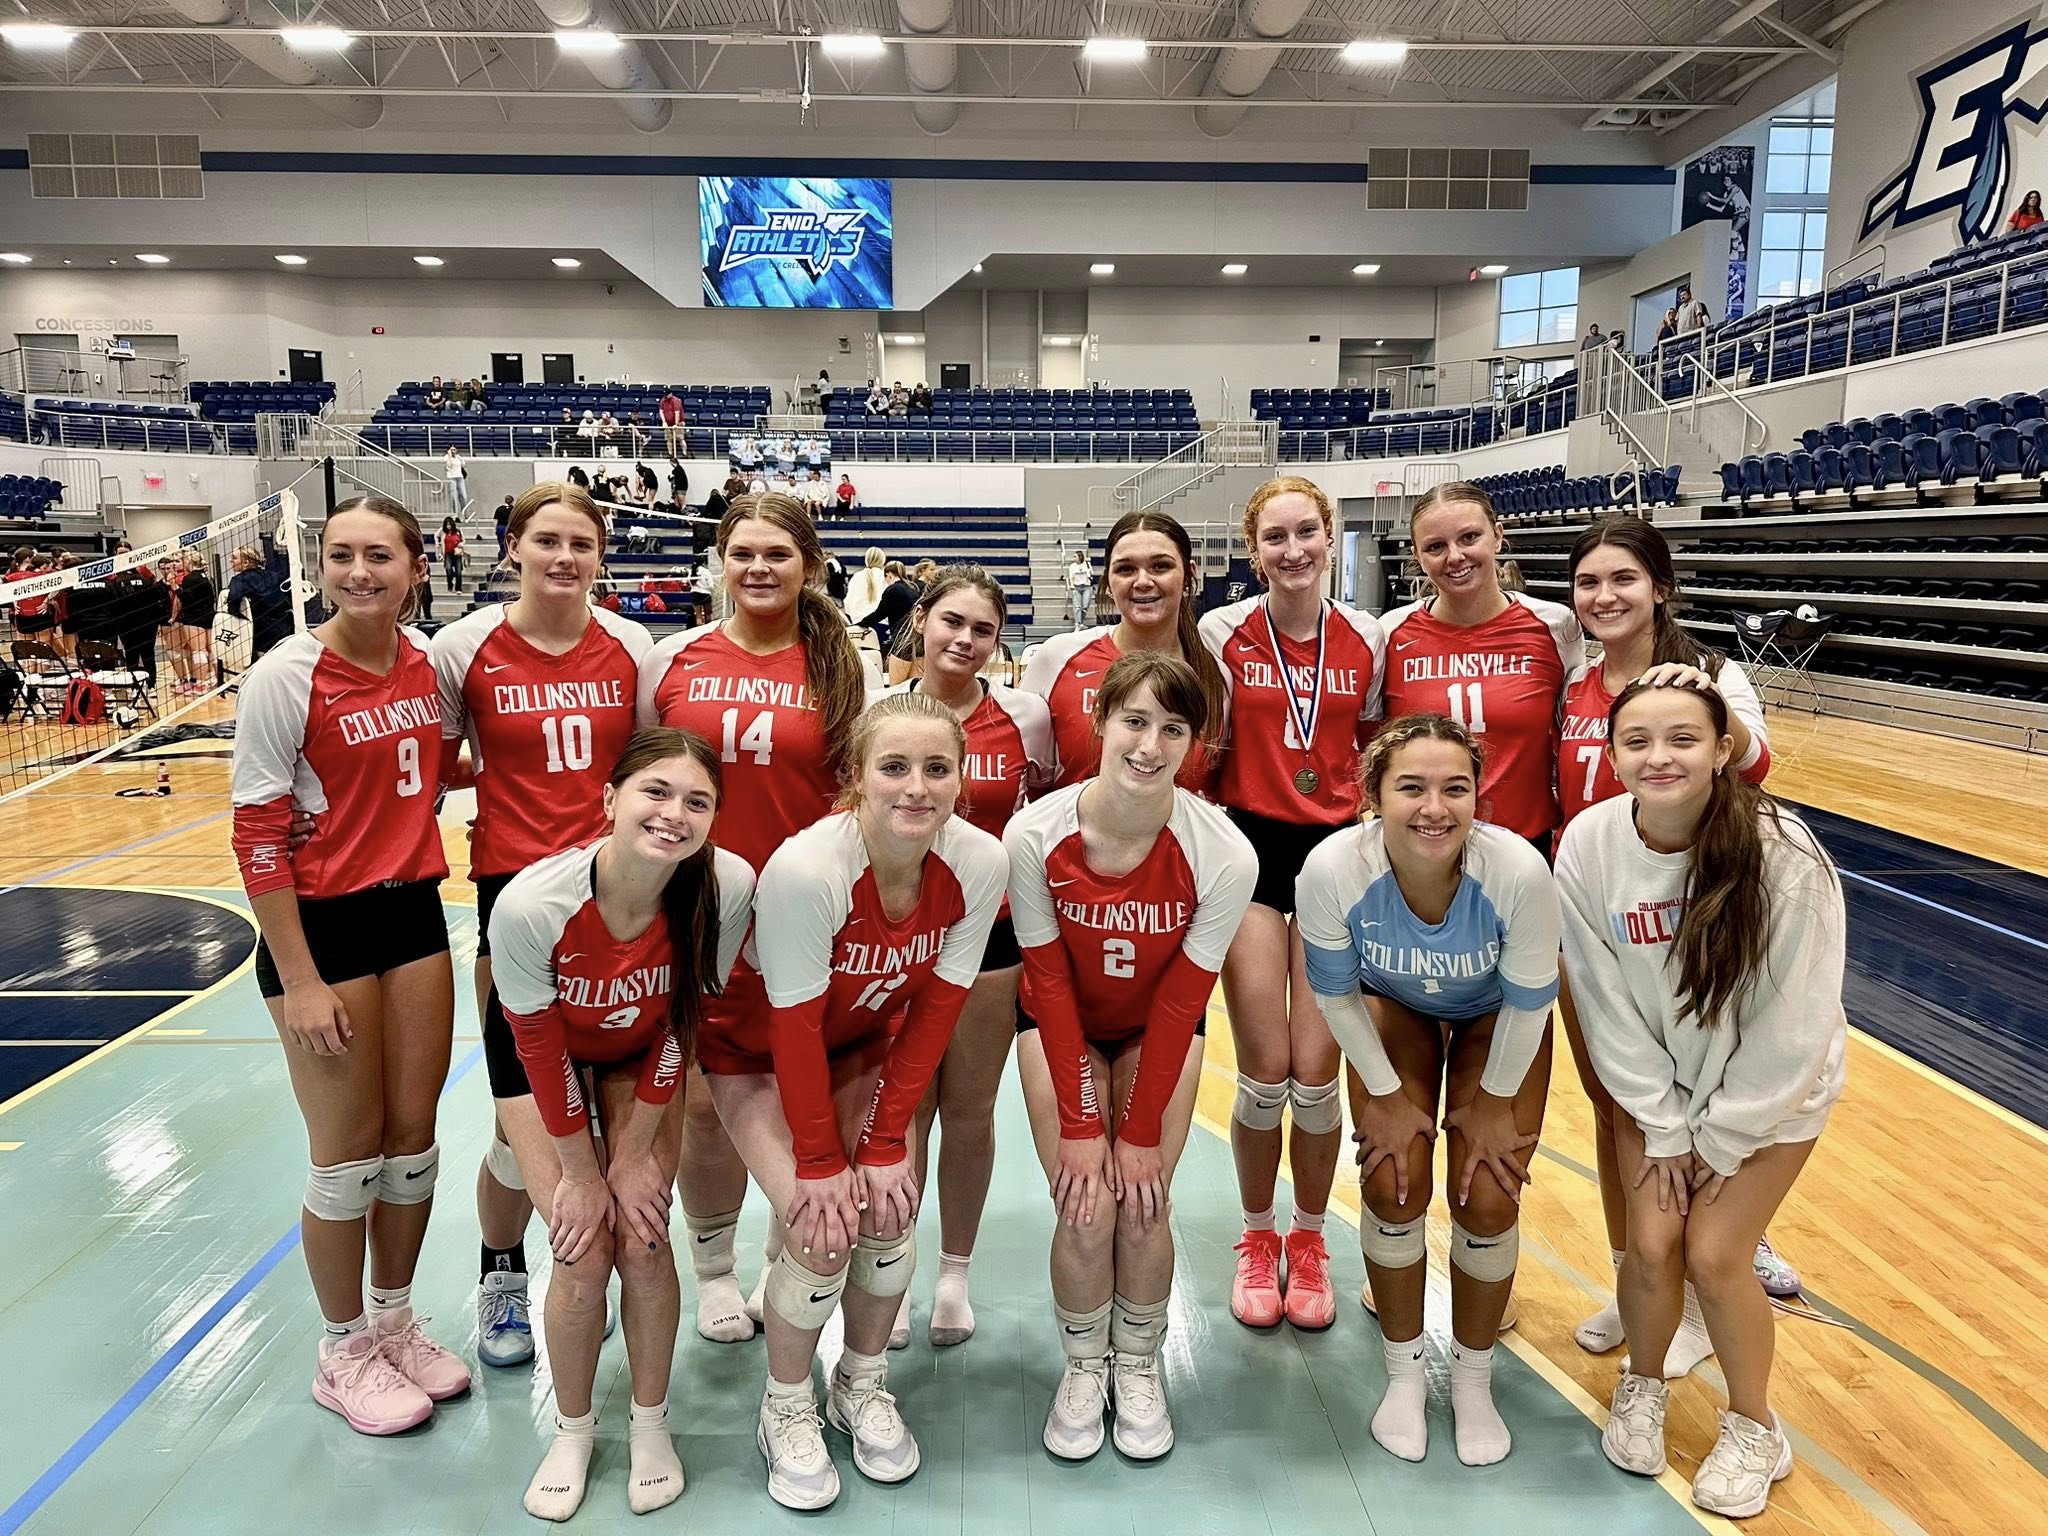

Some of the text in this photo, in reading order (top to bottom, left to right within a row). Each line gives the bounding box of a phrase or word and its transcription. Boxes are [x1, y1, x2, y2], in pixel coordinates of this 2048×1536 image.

[770, 214, 816, 231] ENID
[35, 317, 154, 332] CONCESSIONS
[863, 332, 876, 380] WOMEN
[1090, 333, 1099, 362] MEN
[181, 528, 207, 546] PACERS
[79, 561, 113, 580] PACERS
[1403, 654, 1532, 682] COLLINSVILLE
[494, 680, 623, 714] COLLINSVILLE
[1447, 683, 1487, 733] 11
[338, 693, 442, 746] COLLINSVILLE
[720, 707, 775, 766] 14
[541, 715, 592, 773] 10
[396, 736, 423, 797] 9
[1576, 745, 1603, 802] 7
[1103, 938, 1136, 979] 2
[1362, 940, 1500, 978] COLLINSVILLE
[1078, 1053, 1100, 1121] CARDINALS
[712, 1314, 741, 1326] DRI-FIT
[540, 1485, 571, 1494] DRI-FIT
[639, 1475, 669, 1487] DRI-FIT
